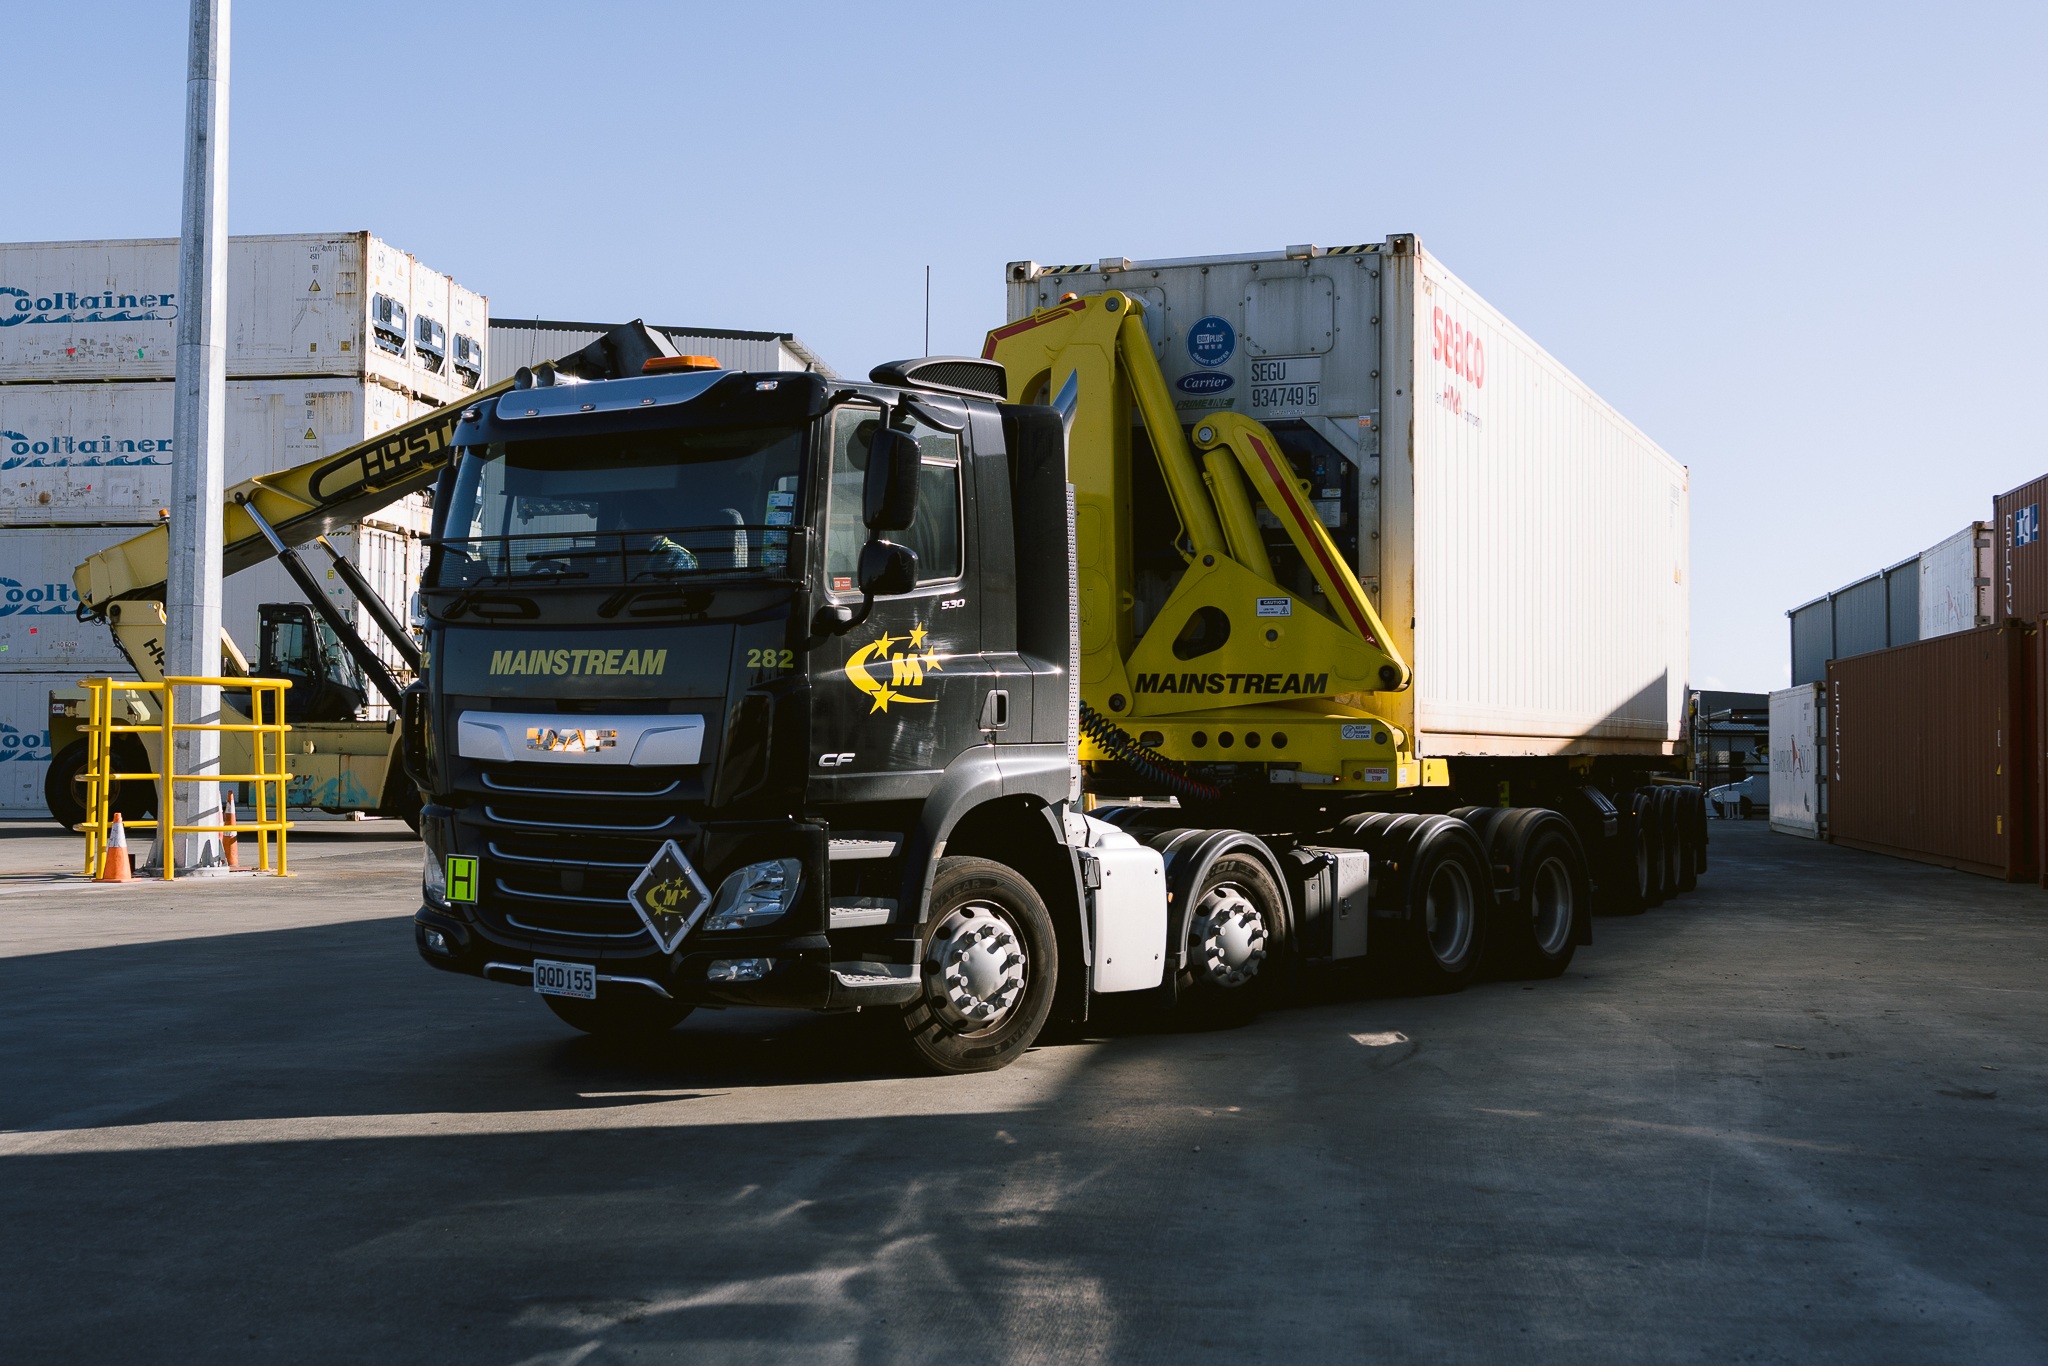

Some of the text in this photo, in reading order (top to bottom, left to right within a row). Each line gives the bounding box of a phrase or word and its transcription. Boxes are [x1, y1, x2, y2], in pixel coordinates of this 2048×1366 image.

[1209, 334, 1224, 343] PLUS
[1433, 305, 1485, 389] seaco
[1192, 350, 1230, 365] SMART REEFER
[1251, 362, 1286, 381] SEGU
[1184, 377, 1227, 389] Carrier
[1176, 398, 1229, 409] PRIMELINE
[1252, 386, 1317, 407] 934749 5
[941, 599, 966, 610] 530
[489, 650, 667, 675] MAINSTREAM
[747, 649, 794, 668] 282
[1135, 673, 1328, 694] MAINSTREAM
[526, 727, 616, 753] DAF
[818, 753, 856, 767] CF
[452, 860, 472, 899] H
[538, 966, 593, 991] QQD155
